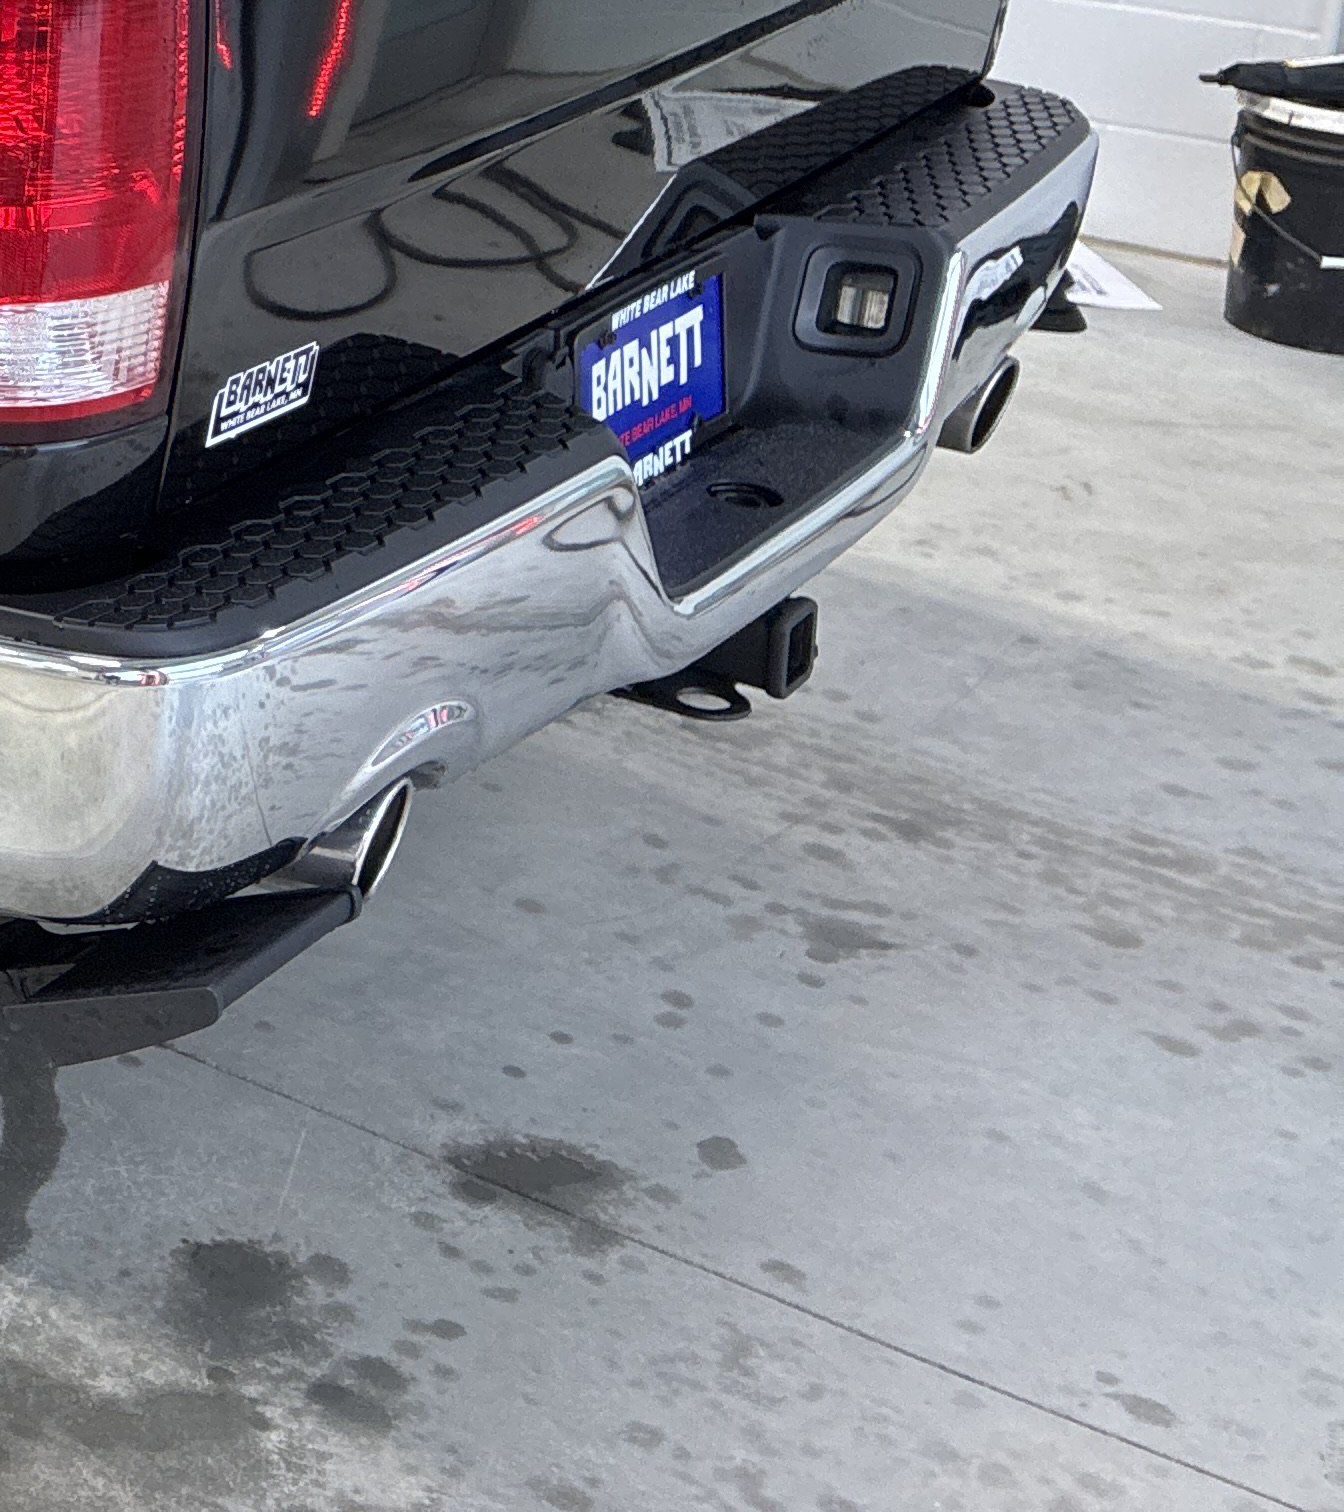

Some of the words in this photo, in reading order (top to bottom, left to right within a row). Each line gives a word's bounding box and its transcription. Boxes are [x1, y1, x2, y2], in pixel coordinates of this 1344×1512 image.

[612, 298, 643, 332] WHITE
[643, 284, 669, 314] BEAR
[670, 269, 696, 299] LAKE
[223, 344, 315, 412] BARNETT
[592, 304, 704, 422] BARNETT
[220, 411, 245, 432] WHITE
[246, 404, 266, 421] BEAR
[289, 386, 303, 401] MN
[632, 416, 654, 443] BEAR
[633, 428, 693, 487] ARNETT
